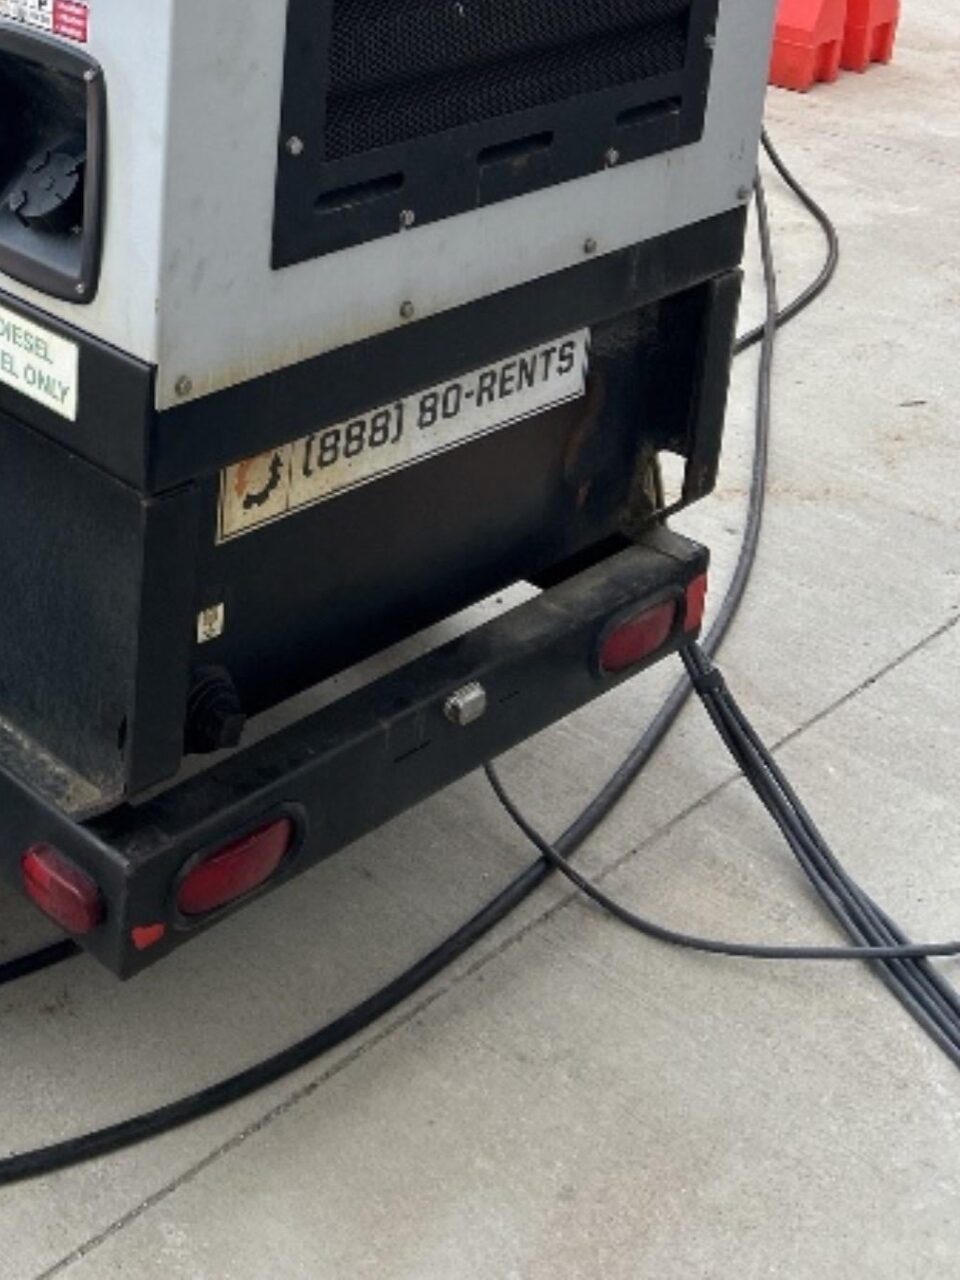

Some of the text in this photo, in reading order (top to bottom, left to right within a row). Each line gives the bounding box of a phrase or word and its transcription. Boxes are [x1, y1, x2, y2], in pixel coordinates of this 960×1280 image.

[23, 362, 71, 405] ONLY
[302, 340, 577, 477] (888) 80-RENTS
